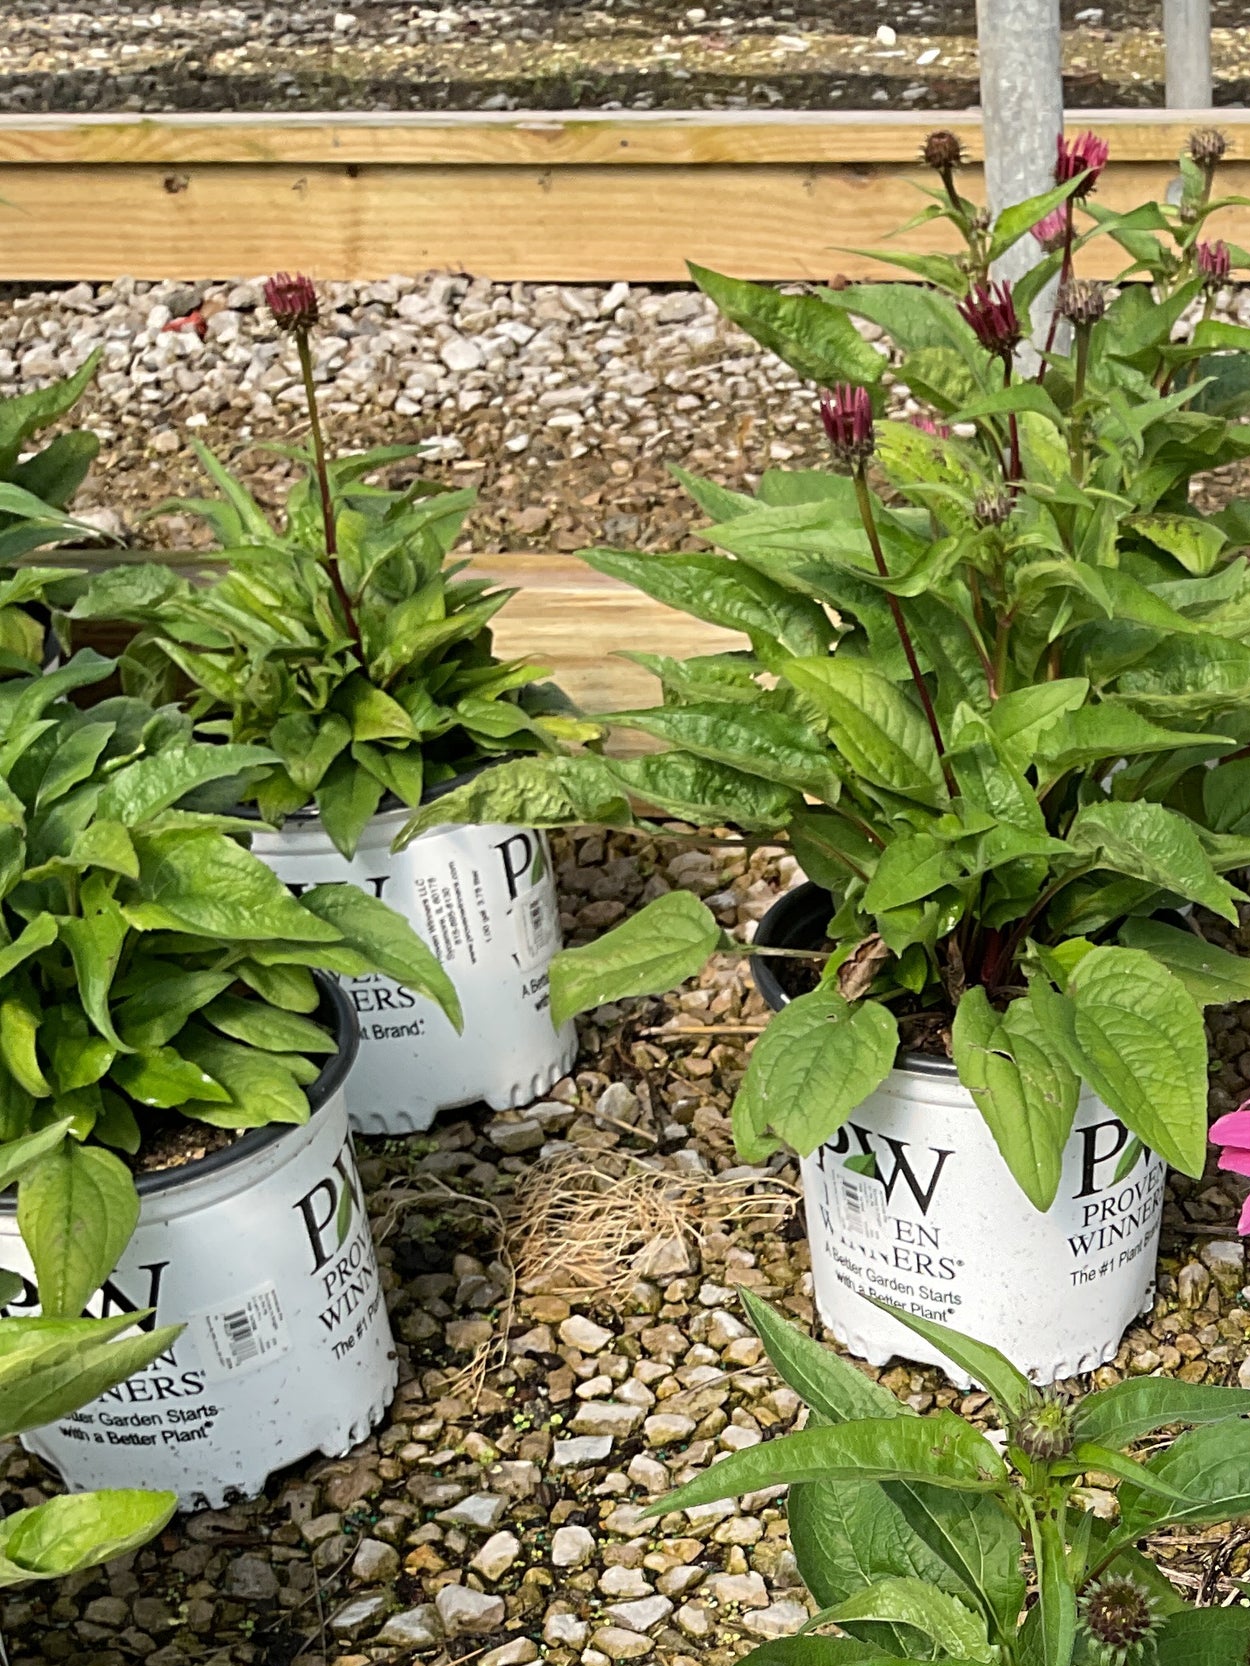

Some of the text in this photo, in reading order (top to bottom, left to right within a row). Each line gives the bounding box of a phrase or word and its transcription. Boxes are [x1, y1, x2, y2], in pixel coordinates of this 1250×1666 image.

[415, 879, 426, 896] LLC
[1070, 1269, 1096, 1287] The
[1099, 1258, 1115, 1277] #1
[1119, 1239, 1143, 1268] Plant
[866, 1268, 915, 1296] Garden
[918, 1286, 962, 1306] Starts
[331, 1335, 355, 1361] The
[356, 1318, 369, 1339] #1
[99, 1411, 163, 1428] Garden
[167, 1403, 219, 1425] Starts
[59, 1425, 90, 1442] with
[94, 1432, 105, 1444] a
[107, 1430, 157, 1446] Better
